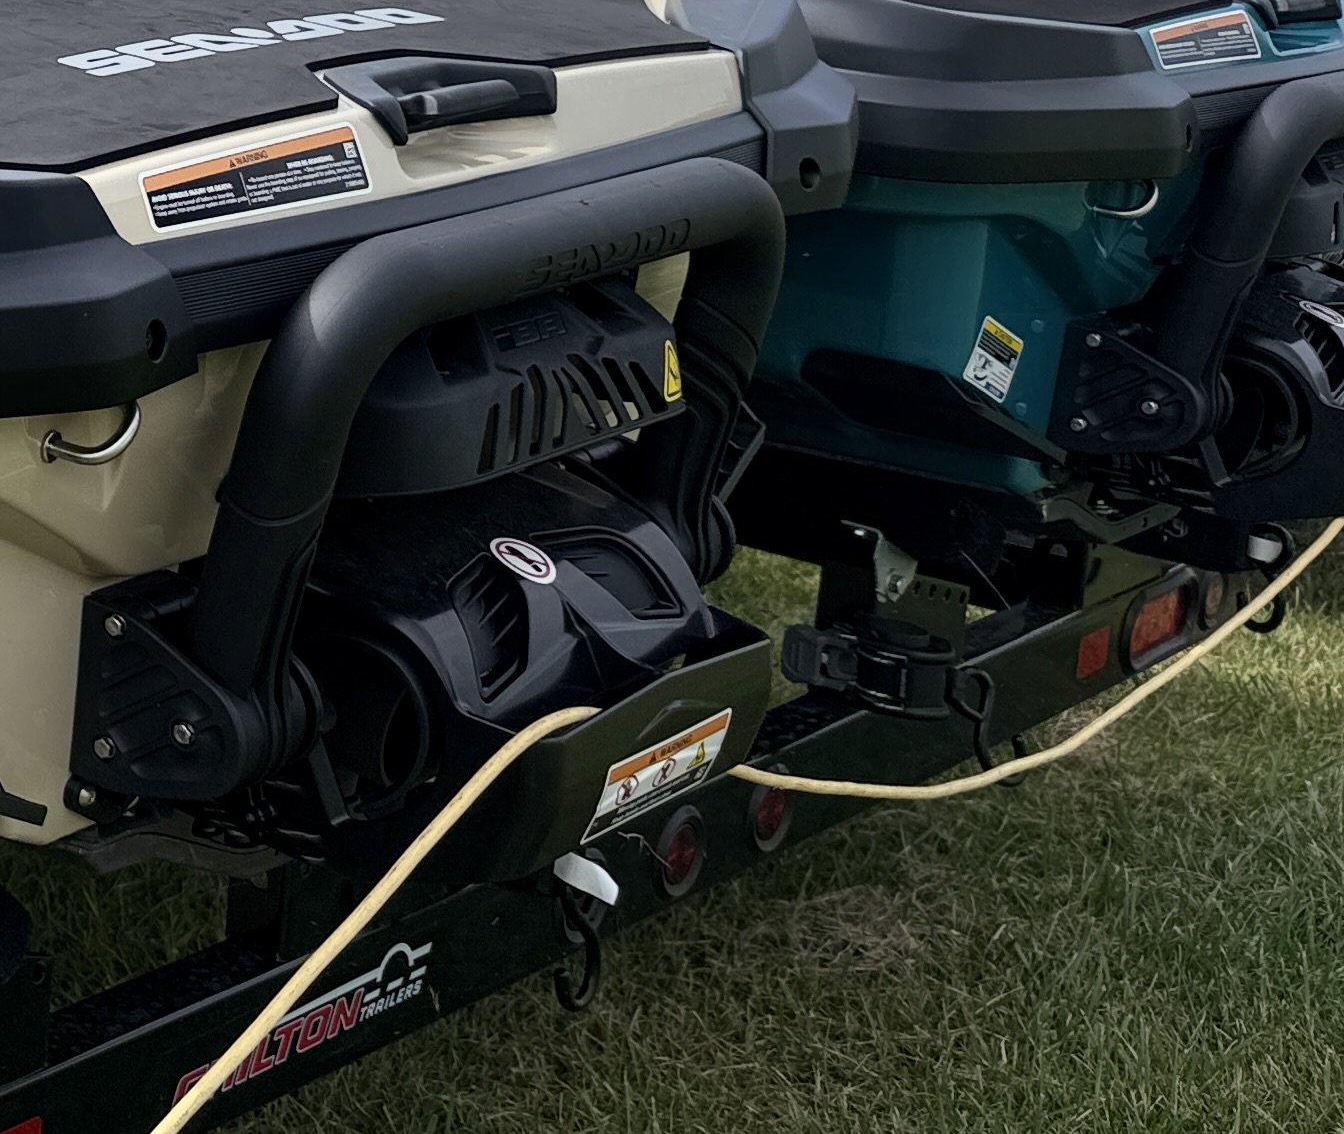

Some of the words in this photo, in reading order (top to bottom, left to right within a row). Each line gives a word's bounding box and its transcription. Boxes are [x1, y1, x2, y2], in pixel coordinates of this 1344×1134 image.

[235, 149, 269, 166] WARNING
[359, 979, 423, 1022] TRAILERS
[172, 987, 366, 1109] CILTON
